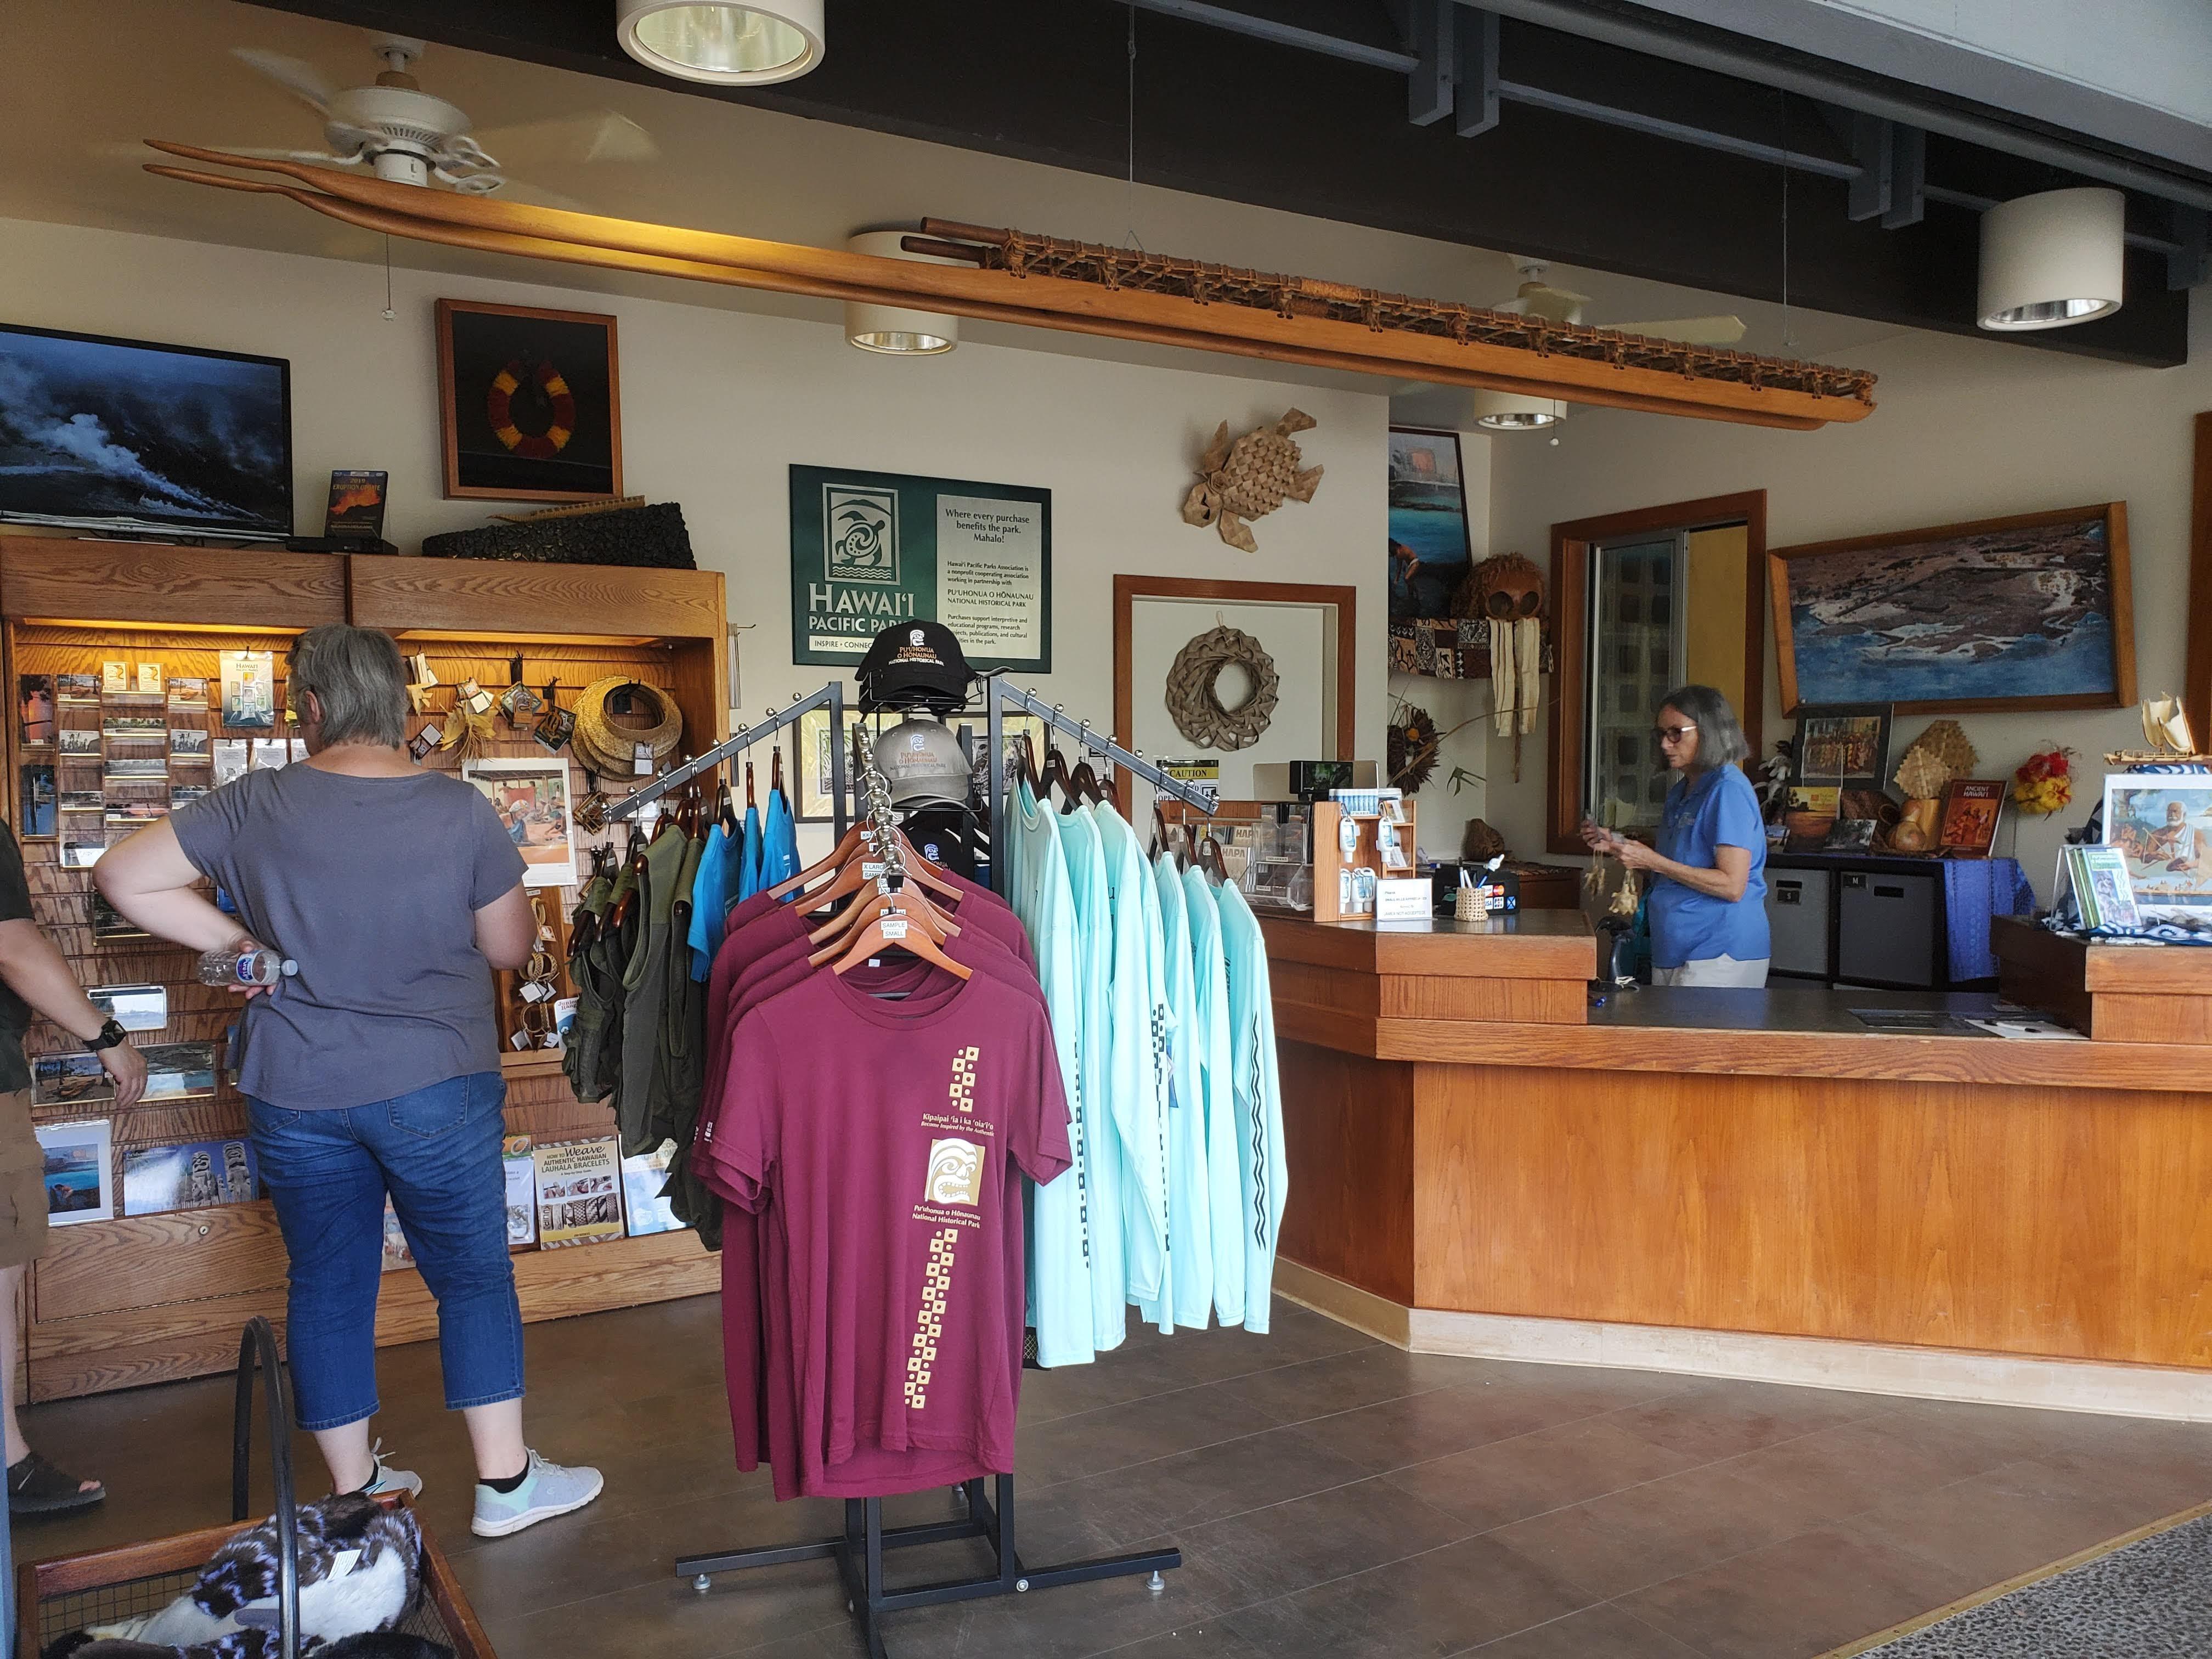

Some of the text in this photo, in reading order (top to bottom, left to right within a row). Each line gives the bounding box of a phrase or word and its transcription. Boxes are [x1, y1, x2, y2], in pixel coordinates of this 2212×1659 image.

[946, 509, 1029, 523] Where every purchase
[957, 520, 1021, 534] benefits the park.
[974, 533, 1004, 543] Mahalo!
[809, 583, 915, 617] HAWAI‘I
[996, 591, 1034, 600] HŌNAUNAU
[809, 616, 866, 633] PACIFIC
[1222, 848, 1245, 857] HAPA
[923, 1113, 949, 1123] Kīpaipai
[565, 1146, 605, 1157] Weave
[541, 1159, 610, 1173] LAUHALA BRACELETS
[544, 1153, 606, 1166] AUTHENTIC HAWAIIAN
[912, 1213, 980, 1229] National Historical Park
[951, 1210, 980, 1221] Hōnaunau
